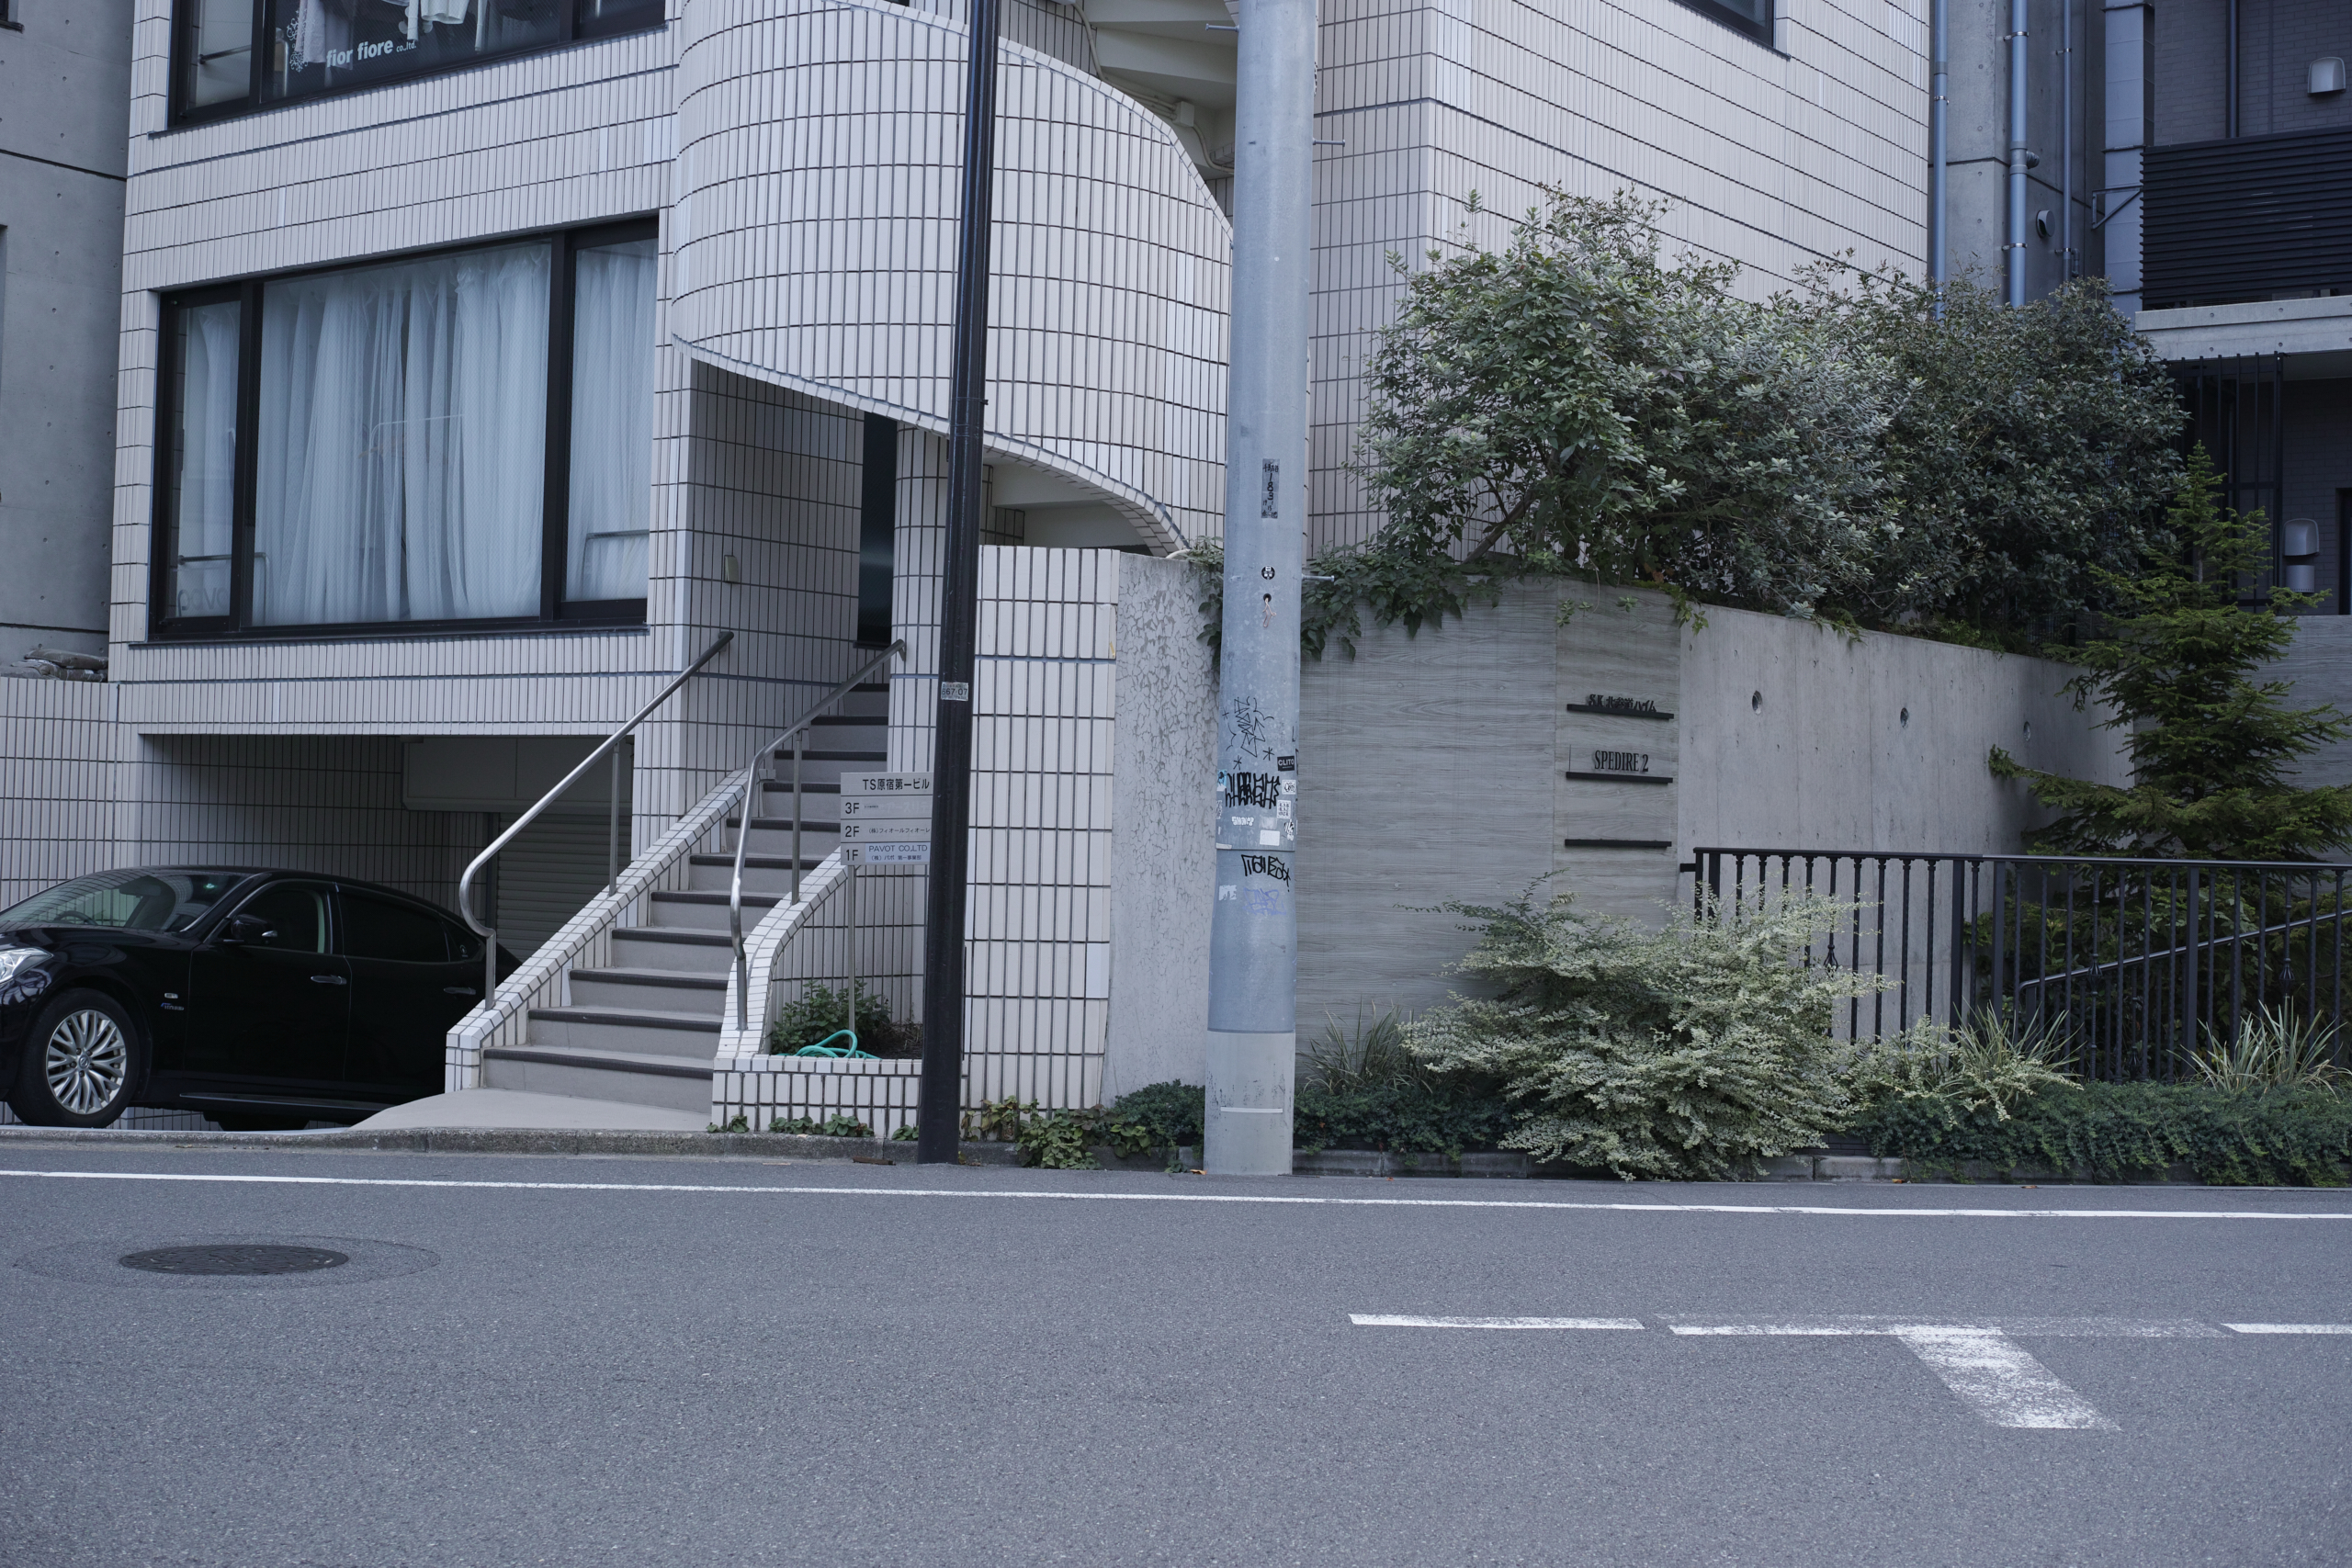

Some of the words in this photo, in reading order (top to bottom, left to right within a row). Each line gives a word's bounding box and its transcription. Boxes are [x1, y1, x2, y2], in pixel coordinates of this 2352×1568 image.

[326, 49, 354, 68] fior
[357, 39, 394, 61] fiore
[1594, 750, 1640, 772] SPEDIRE
[1642, 753, 1648, 772] 2
[862, 778, 930, 791] TS原宿第一ビル
[844, 802, 860, 815] 3F
[844, 825, 860, 838] 2F
[868, 844, 896, 852] PAVOT
[845, 849, 859, 862] 1F
